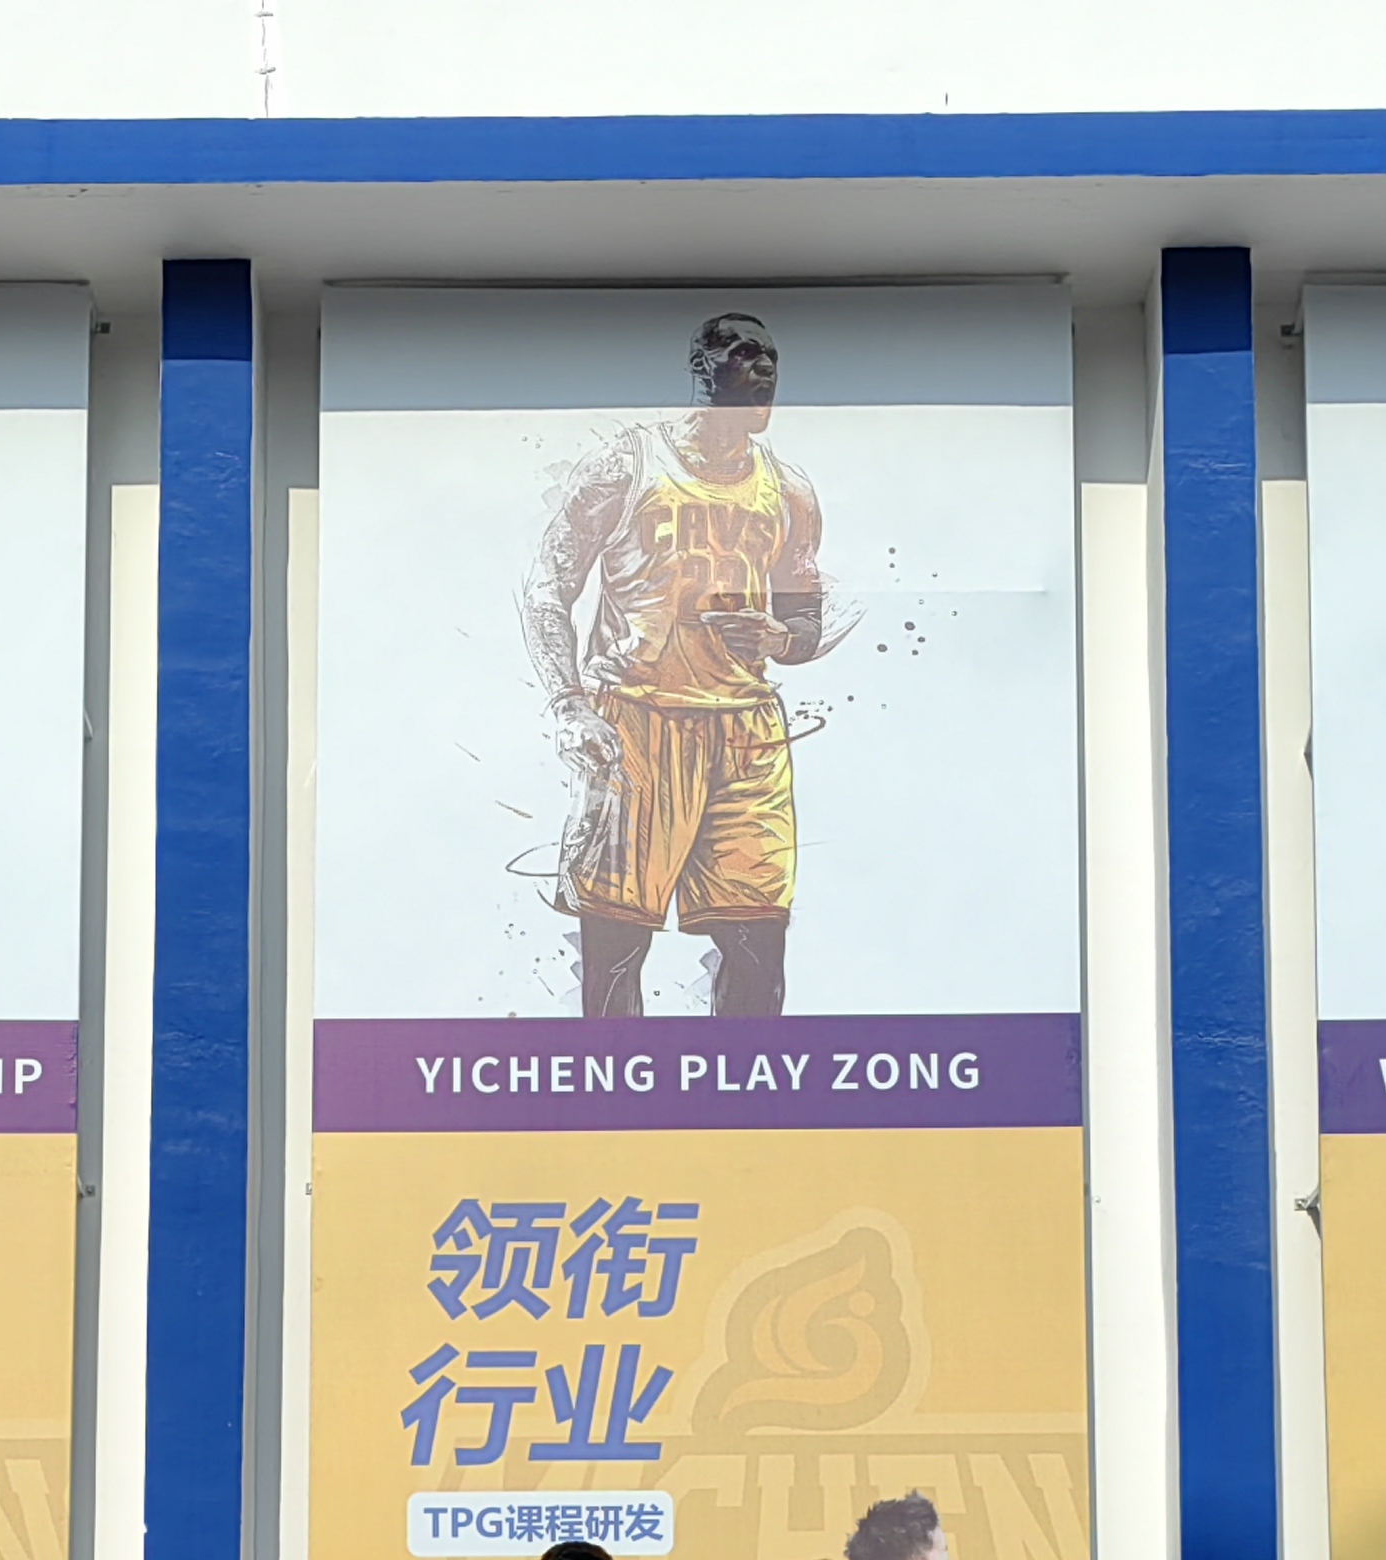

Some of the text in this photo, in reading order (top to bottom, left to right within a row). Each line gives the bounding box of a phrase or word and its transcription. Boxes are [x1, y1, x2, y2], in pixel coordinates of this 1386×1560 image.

[415, 1052, 981, 1093] YICHENG PLAY ZONG
[428, 1196, 700, 1321] 领衔
[401, 1343, 673, 1467] 行业
[422, 1501, 666, 1545] TPG课程研发
